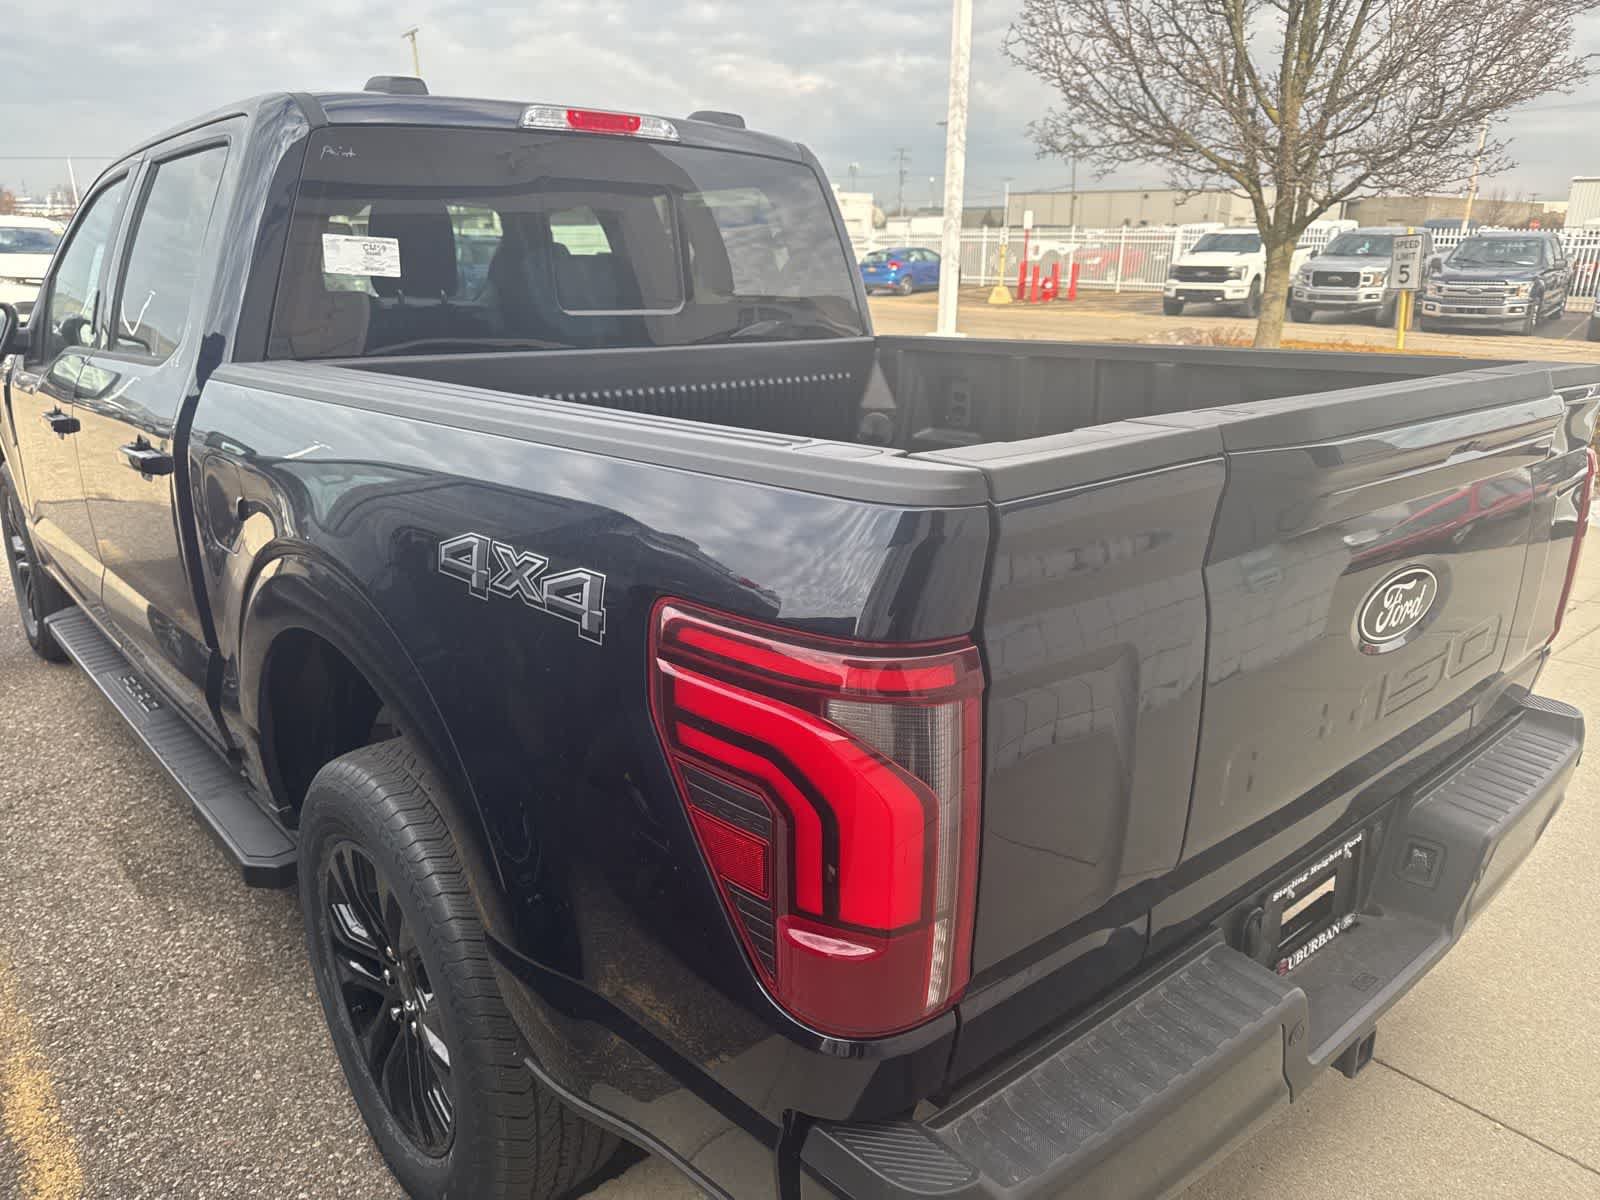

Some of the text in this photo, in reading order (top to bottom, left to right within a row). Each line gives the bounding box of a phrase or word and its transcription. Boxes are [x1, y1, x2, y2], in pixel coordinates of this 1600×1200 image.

[1393, 240, 1420, 249] SPEED
[1395, 251, 1416, 261] LIMIT
[1398, 264, 1410, 284] 5
[1374, 578, 1428, 633] Ford
